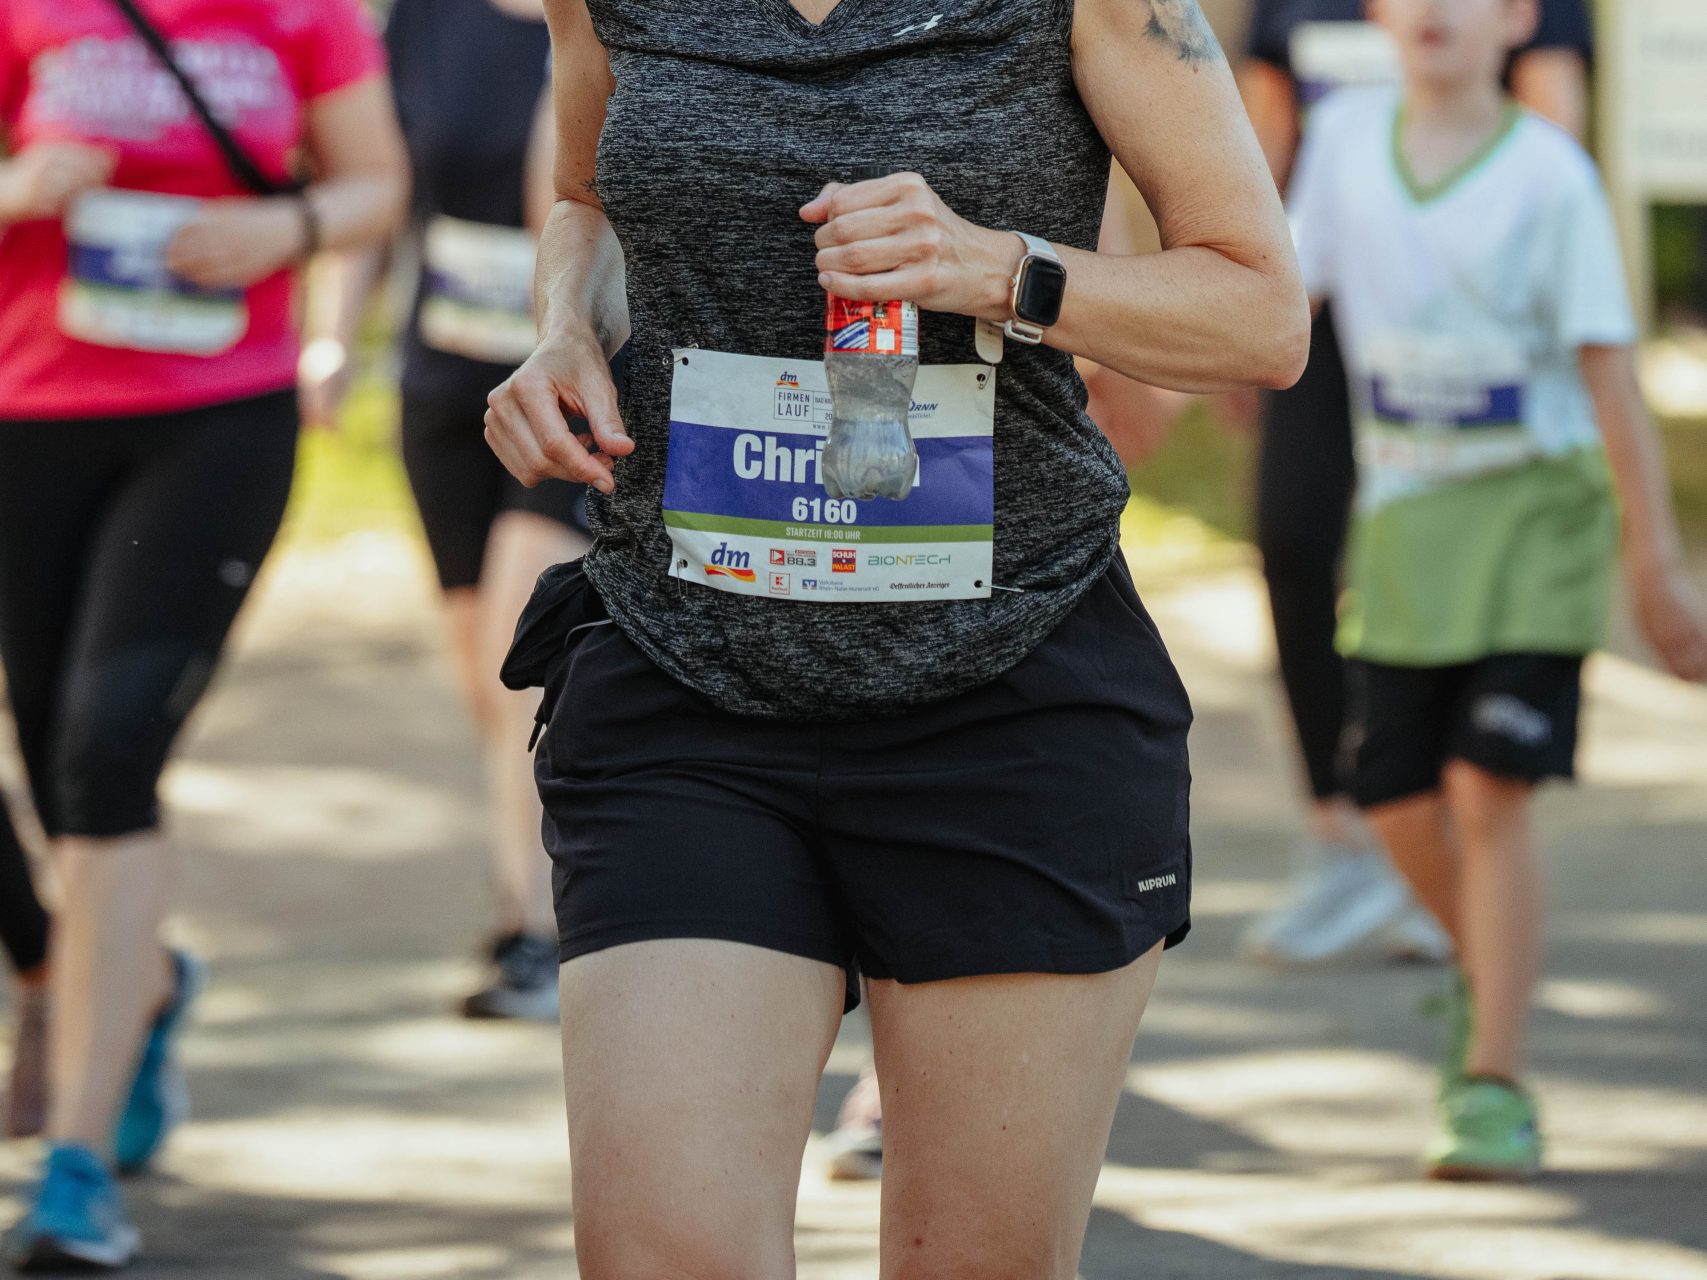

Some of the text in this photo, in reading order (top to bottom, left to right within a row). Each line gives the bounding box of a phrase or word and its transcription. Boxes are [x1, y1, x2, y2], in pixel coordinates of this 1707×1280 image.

[780, 371, 797, 382] dm
[778, 392, 810, 404] FIRMEN
[777, 403, 810, 417] LAUF
[792, 497, 857, 524] 6160
[786, 527, 823, 539] STARTZEIT
[845, 530, 861, 540] UHR
[711, 542, 750, 568] dm
[787, 557, 816, 566] 88.3
[868, 554, 951, 566] BIONTECH
[1138, 873, 1176, 892] KIPRUN
